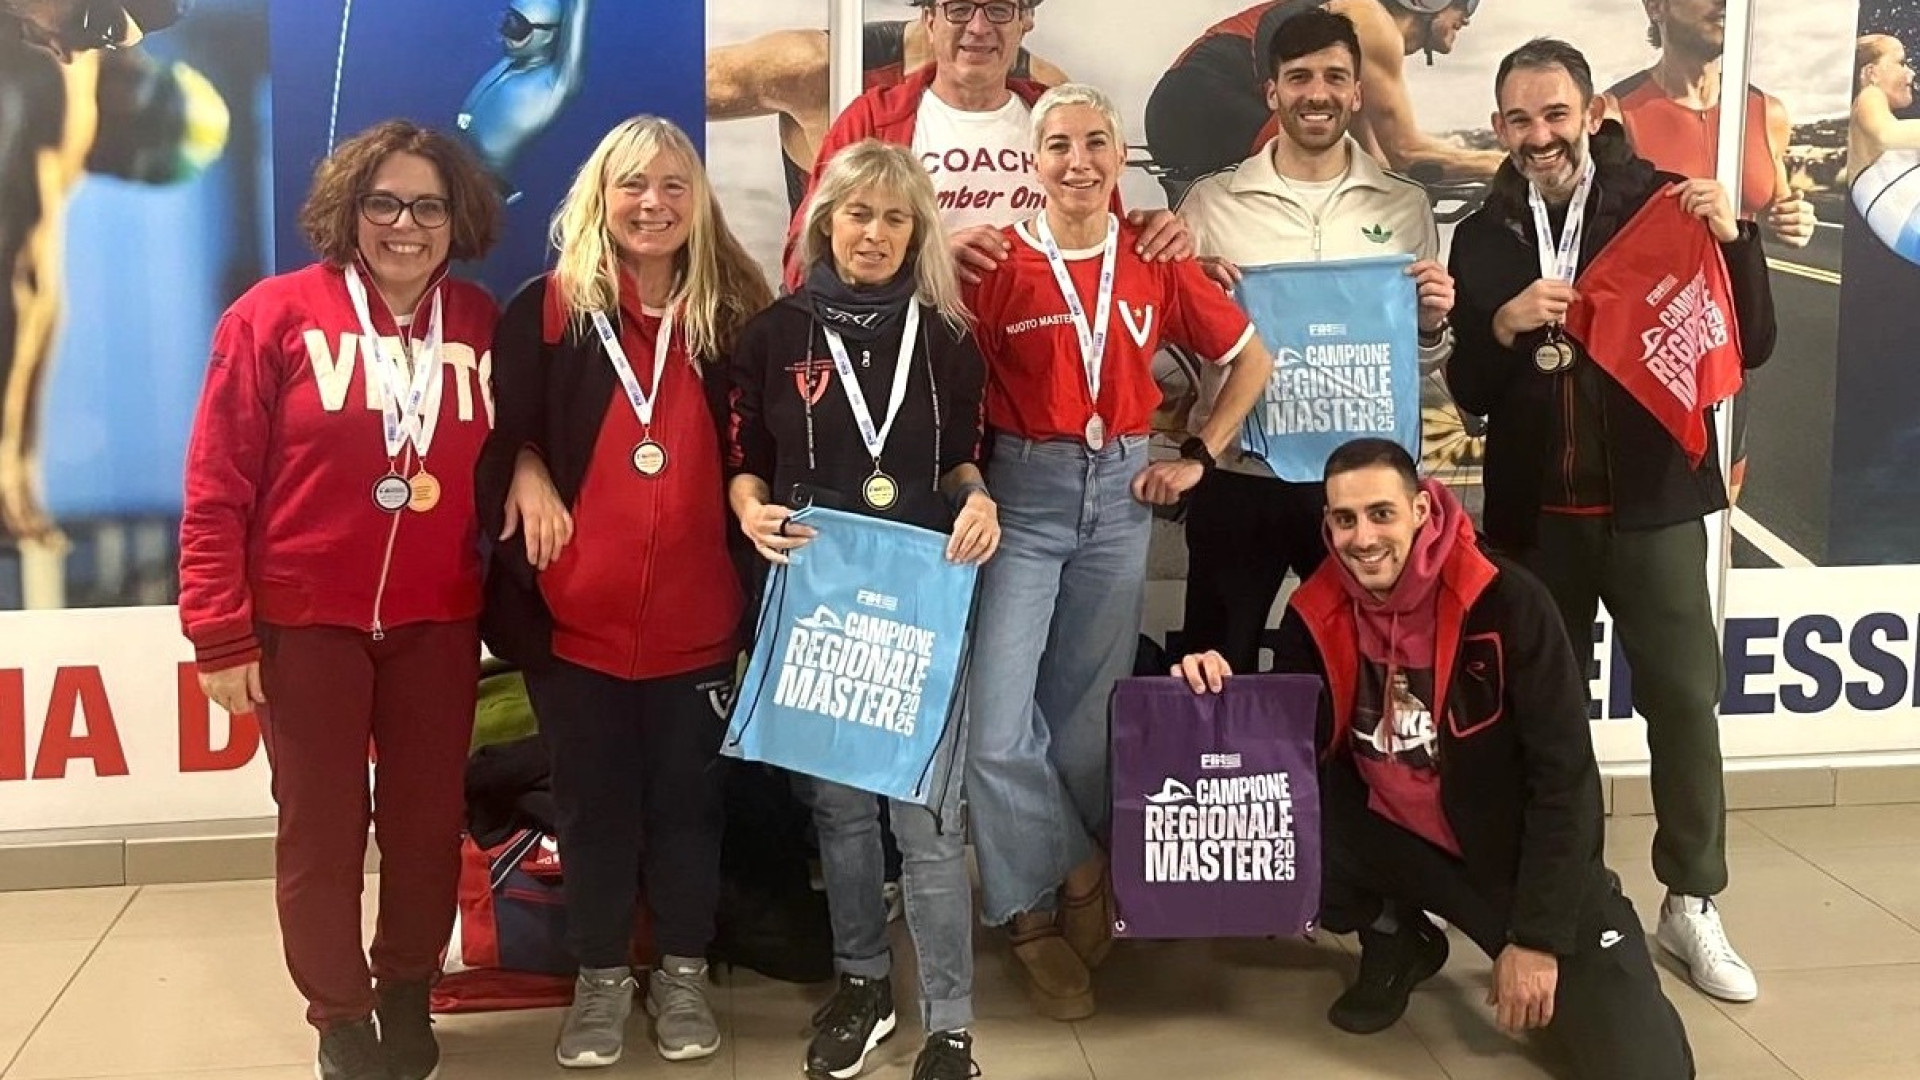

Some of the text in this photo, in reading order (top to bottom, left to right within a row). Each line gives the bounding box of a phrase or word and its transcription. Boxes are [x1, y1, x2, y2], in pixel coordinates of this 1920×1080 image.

[921, 147, 1034, 174] COACH
[1005, 317, 1038, 334] NUOTO
[1306, 342, 1391, 366] CAMPIONE
[1266, 366, 1392, 402] REGIONALE
[1266, 398, 1376, 436] MASTER
[1377, 415, 1395, 432] 25
[844, 612, 936, 657] CAMPIONE
[784, 626, 931, 695] REGIONALE
[773, 664, 901, 730] MASTER
[898, 693, 921, 714] 20
[894, 712, 916, 737] 25
[1196, 772, 1291, 804] CAMPIONE
[1145, 800, 1294, 841] REGIONALE
[1145, 839, 1274, 882] MASTER
[1274, 838, 1295, 859] 20
[1274, 860, 1295, 881] 25
